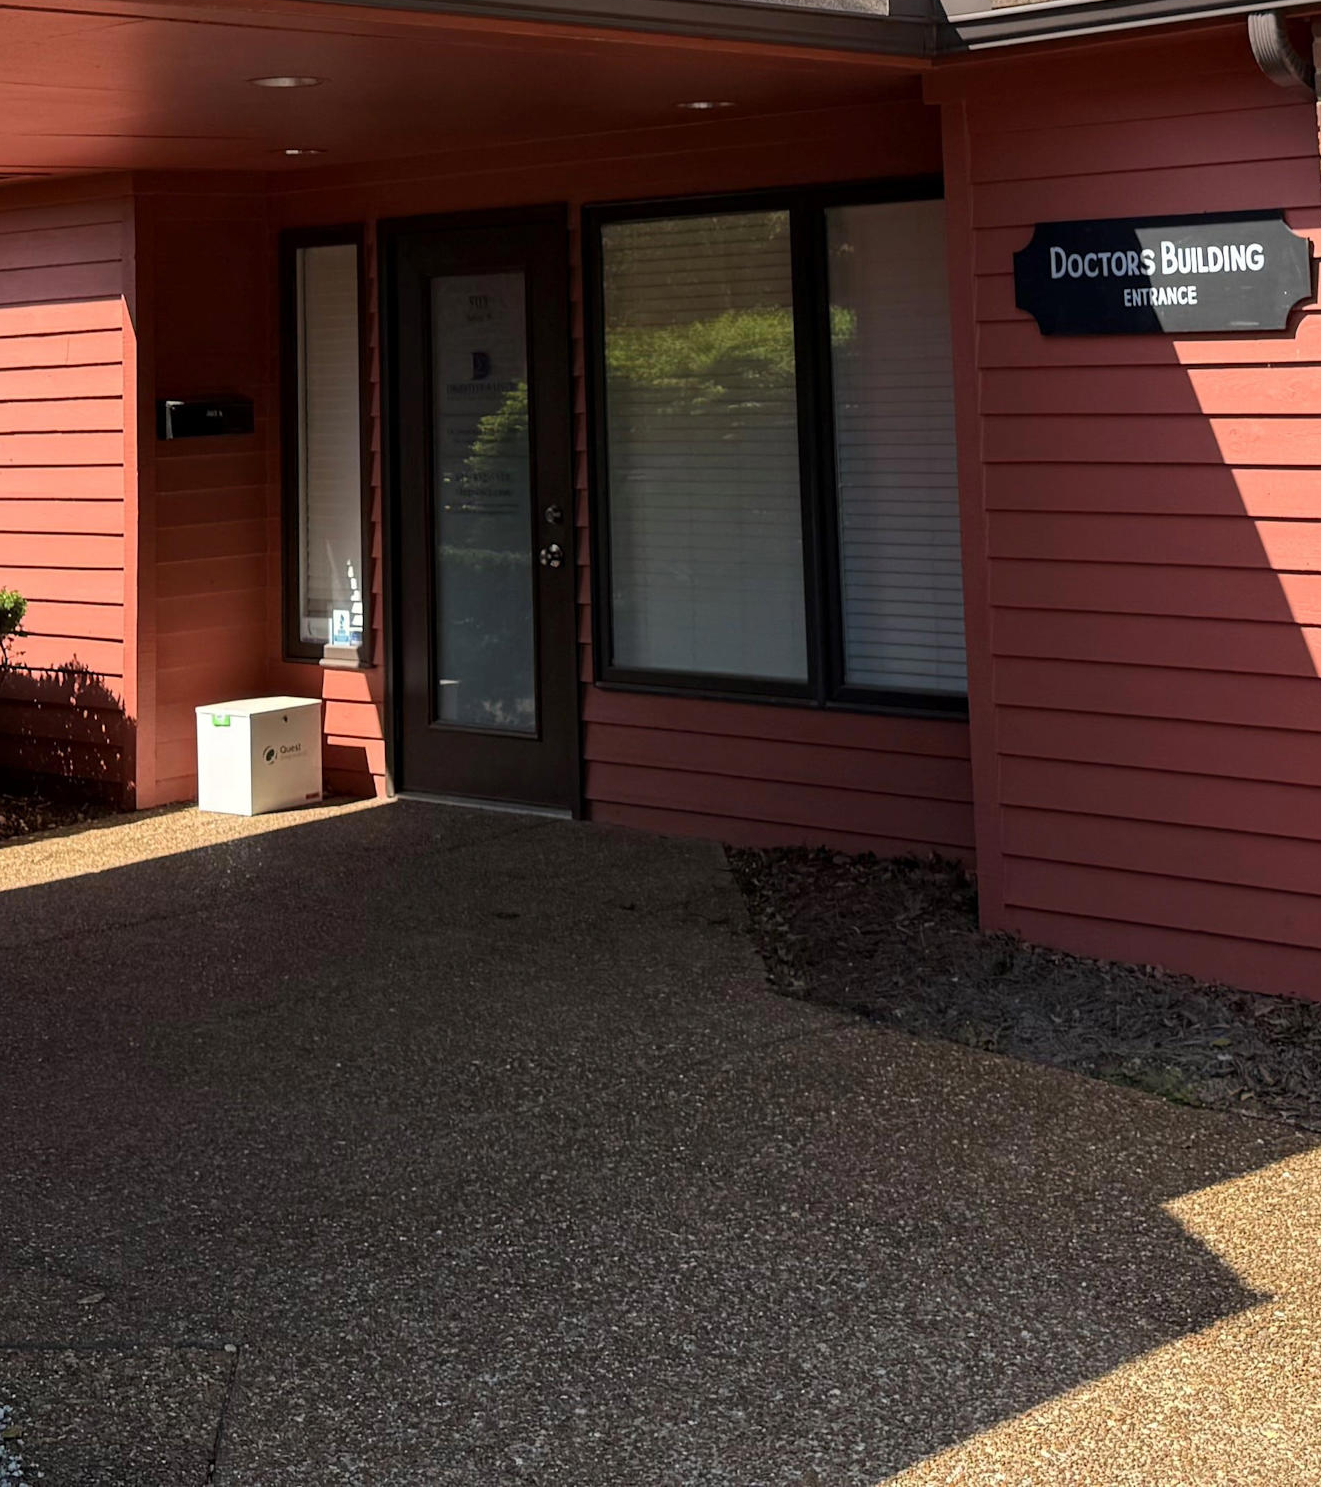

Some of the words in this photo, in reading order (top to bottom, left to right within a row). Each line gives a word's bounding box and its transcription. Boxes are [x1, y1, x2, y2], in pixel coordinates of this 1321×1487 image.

[1049, 246, 1156, 279] DOCTORS
[1160, 240, 1265, 275] BUILDING
[1123, 286, 1198, 307] ENTRANCE
